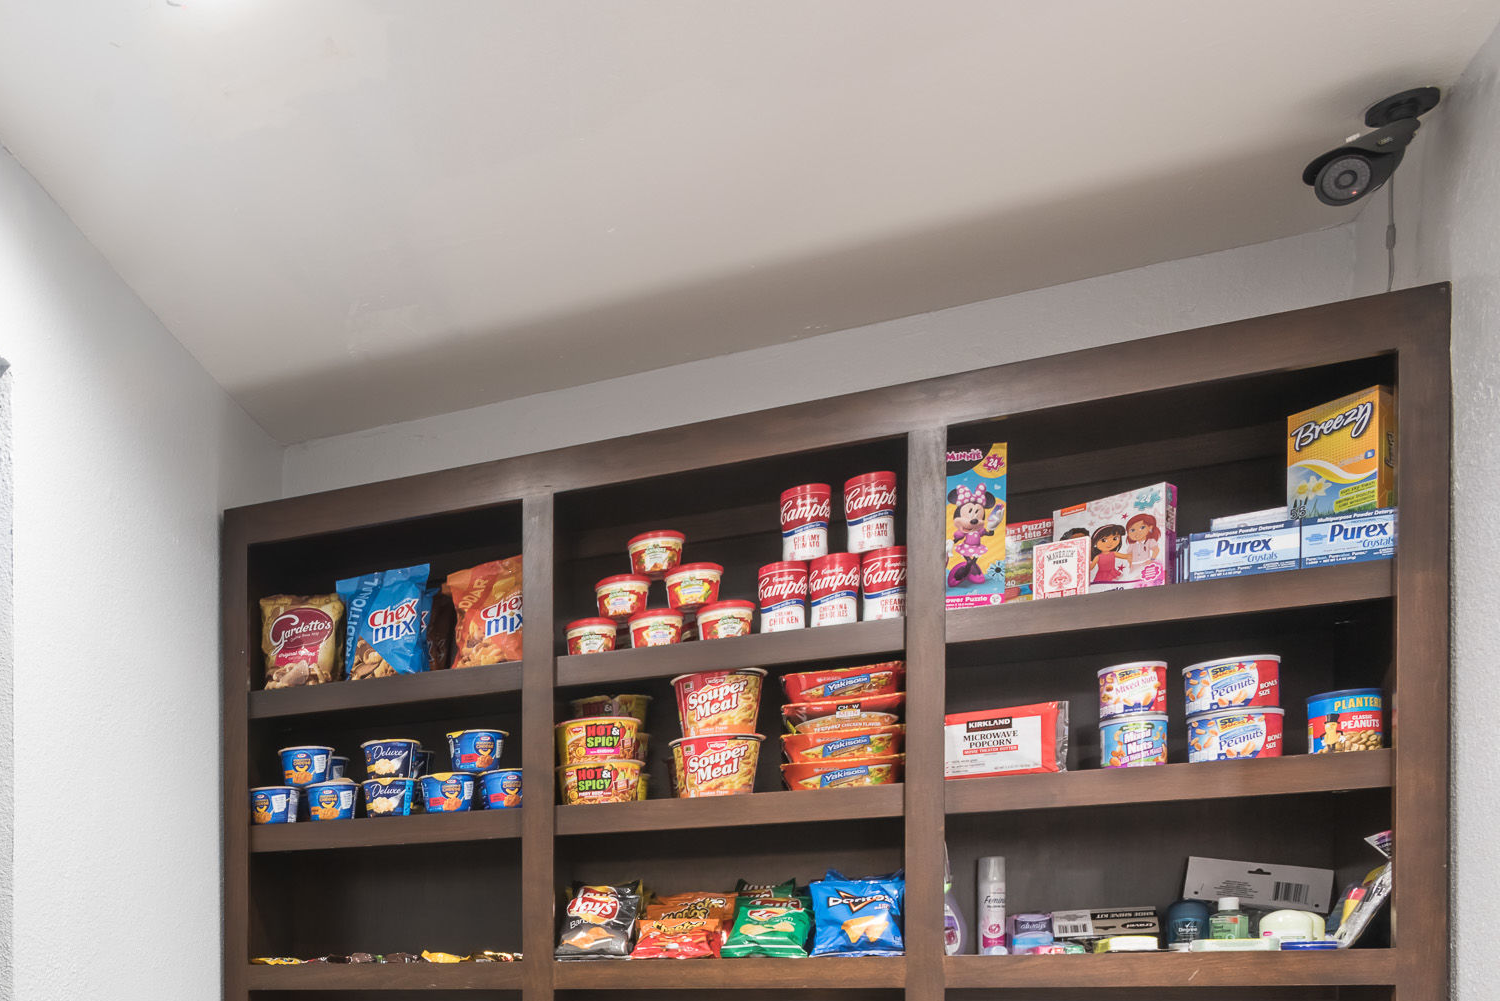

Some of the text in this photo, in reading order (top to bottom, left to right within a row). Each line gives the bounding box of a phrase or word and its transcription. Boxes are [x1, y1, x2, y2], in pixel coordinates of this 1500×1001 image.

[1290, 401, 1373, 452] Breezy
[946, 449, 983, 461] MINNIE
[988, 458, 998, 468] 24
[1021, 519, 1052, 533] Puzzle
[1205, 523, 1285, 538] Multipurpose Powder Detergent
[1329, 522, 1389, 542] Purex
[1216, 537, 1272, 557] Purex
[1247, 551, 1278, 563] Crystals
[965, 595, 988, 603] Puzzle
[368, 597, 418, 627] Chex
[269, 614, 332, 656] Gardetto's
[372, 614, 416, 645] mix
[827, 676, 868, 692] Yakisoba
[1115, 675, 1157, 694] Mixed Nuts
[1211, 677, 1256, 700] Peanuts
[688, 680, 748, 711] Souper
[1258, 689, 1271, 697] SIZE
[695, 692, 739, 721] Meal
[586, 724, 620, 737] HOT &
[968, 718, 1011, 729] KIRKLAND
[1340, 719, 1380, 730] PEANUTS
[586, 736, 620, 748] SPICY
[963, 730, 1018, 742] MICROWAVE
[1123, 729, 1152, 744] Mixed
[1219, 728, 1264, 750] Peanuts
[826, 736, 868, 752] Yakisoba
[969, 739, 1012, 749] POPCORN
[1127, 740, 1153, 756] Nuts
[1265, 742, 1277, 750] SIZE
[371, 745, 403, 759] Deluxe
[688, 744, 749, 773] Souper
[577, 768, 611, 781] HOT &
[695, 757, 739, 785] Meal
[824, 767, 866, 782] Yakisoba
[370, 783, 401, 796] Deluxe
[578, 779, 611, 791] SPICY
[1020, 922, 1047, 931] always
